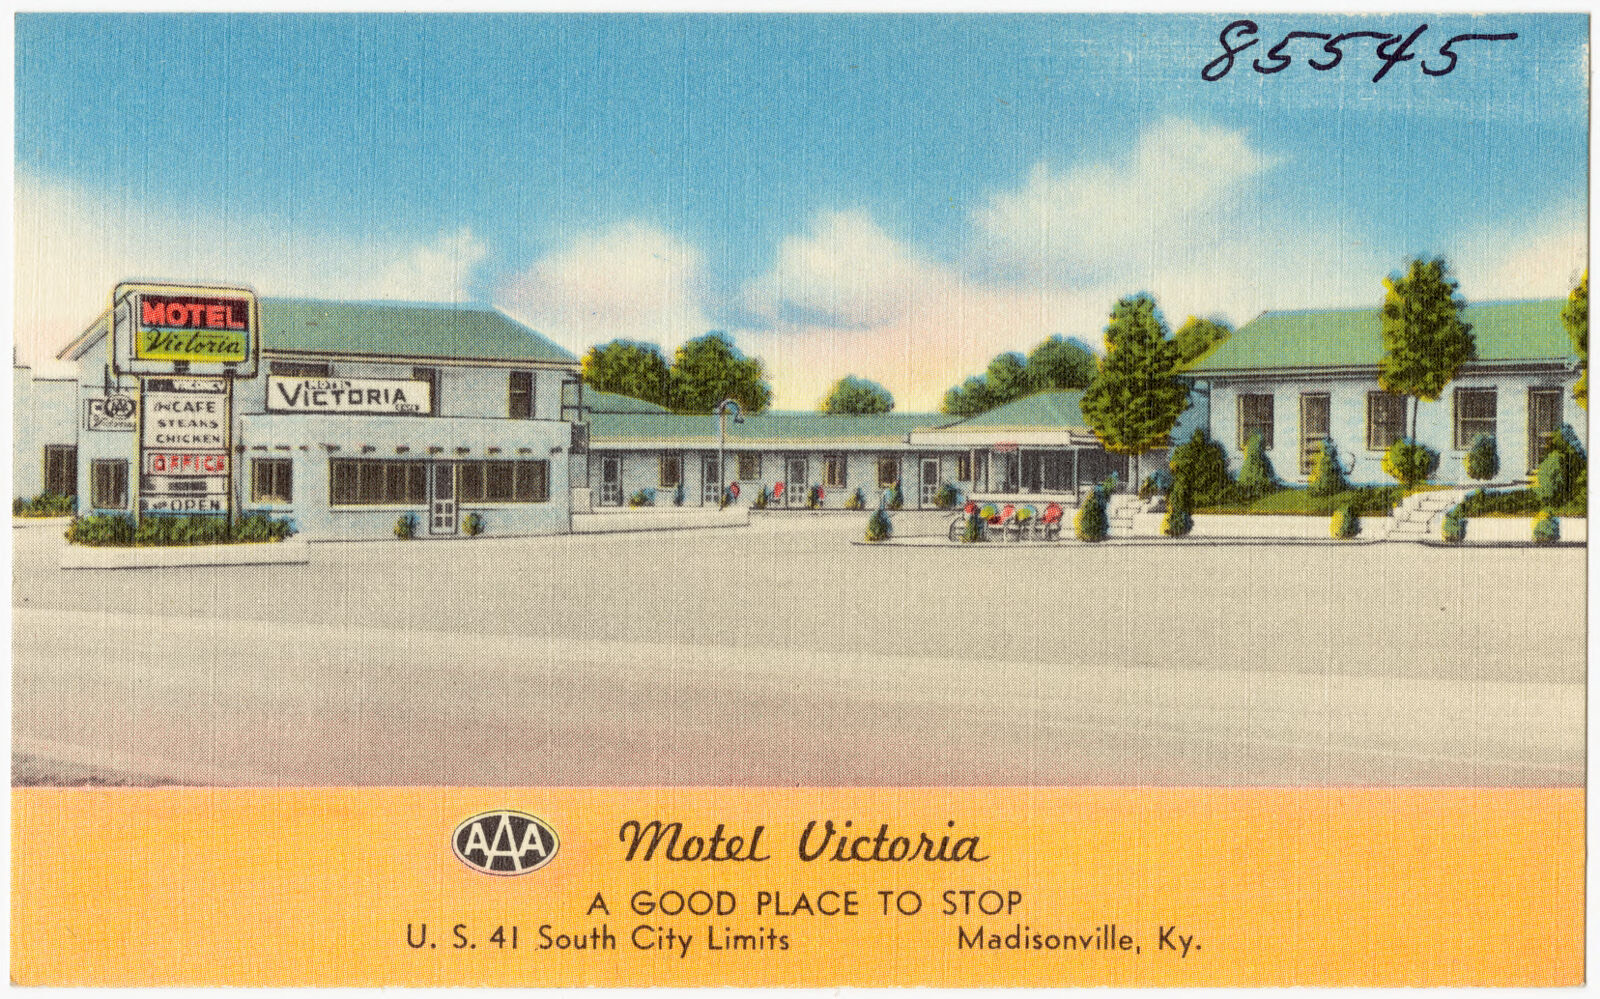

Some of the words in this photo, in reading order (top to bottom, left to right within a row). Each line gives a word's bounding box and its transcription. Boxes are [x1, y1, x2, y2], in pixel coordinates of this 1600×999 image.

[1201, 19, 1519, 83] 85545
[142, 301, 245, 328] MOTEL
[145, 328, 240, 353] Victoria
[277, 381, 407, 407] VICTORIA
[172, 401, 216, 413] CAFE
[157, 418, 219, 429] STEAKS
[156, 433, 220, 444] CHICKEN
[154, 454, 225, 472] OFFICE
[170, 499, 221, 511] OPEN
